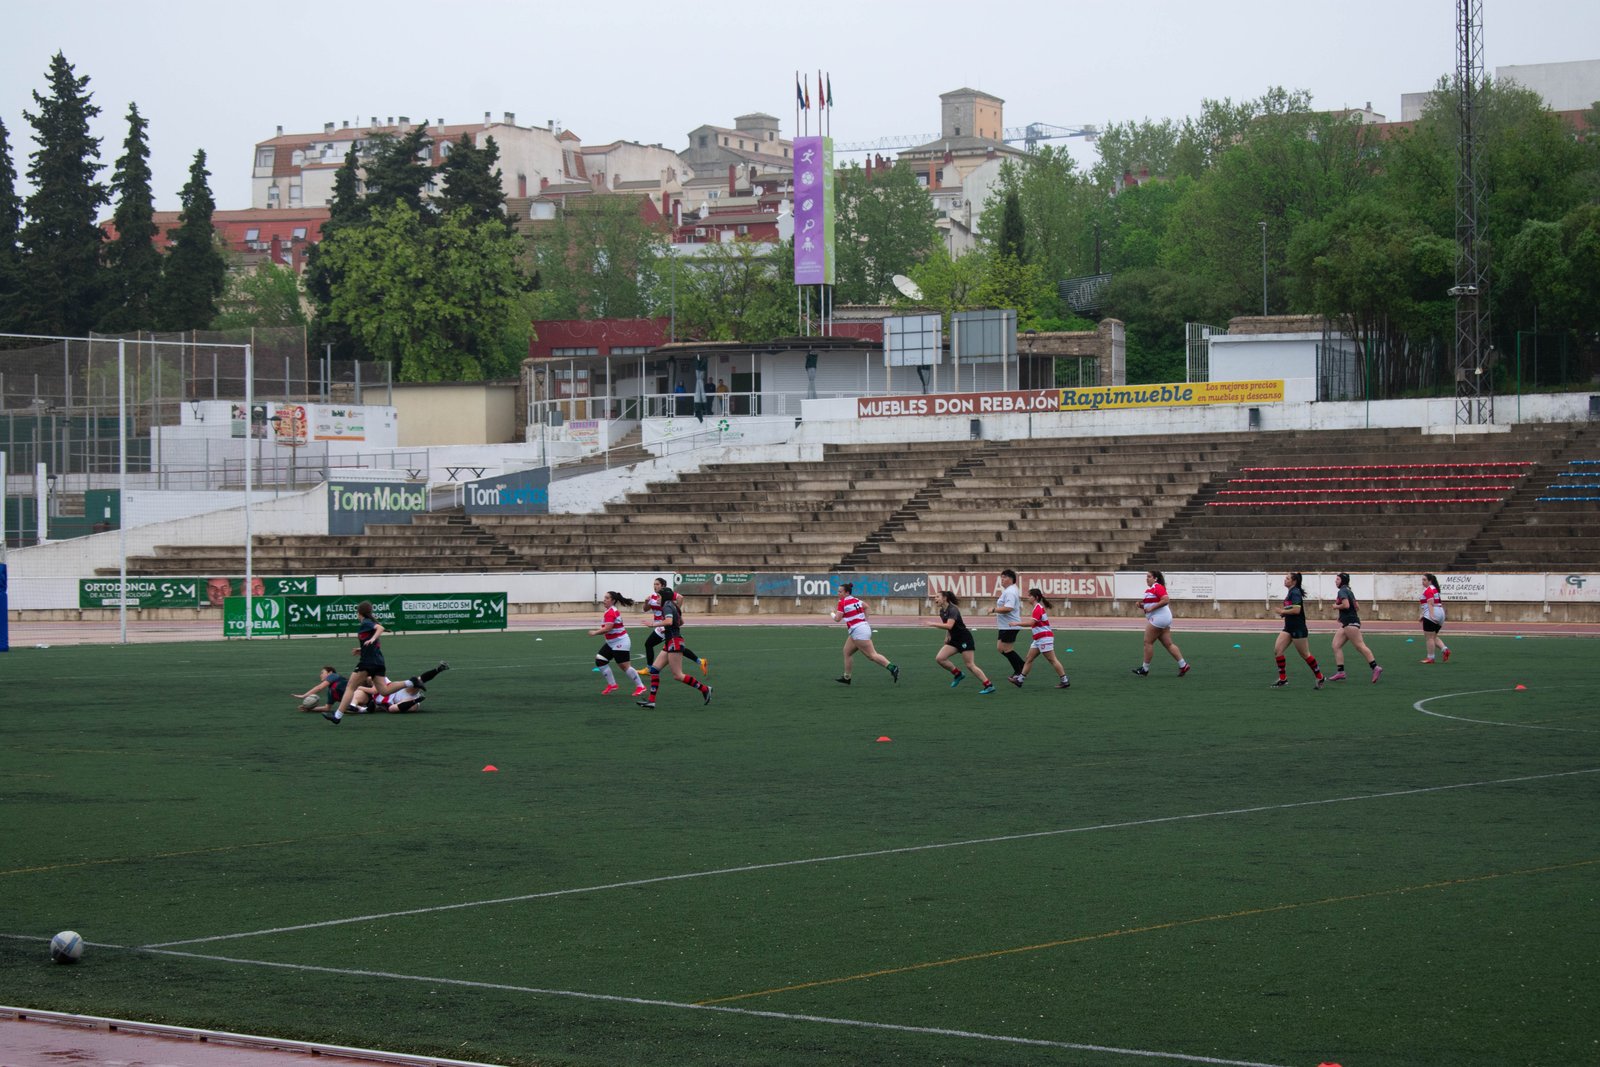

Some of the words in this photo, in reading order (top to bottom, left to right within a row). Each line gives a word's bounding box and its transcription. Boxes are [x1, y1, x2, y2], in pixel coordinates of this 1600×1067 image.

[1220, 383, 1249, 392] mejores
[1250, 382, 1277, 391] precios
[1061, 386, 1193, 408] Rapimueble
[1208, 393, 1239, 401] muebles
[1240, 394, 1245, 402] y
[1246, 392, 1282, 400] descanso
[859, 399, 928, 416] MUEBLES
[935, 398, 974, 413] DON
[980, 391, 1058, 412] REBAJÓN
[1445, 575, 1472, 583] MESÓN
[84, 582, 157, 592] ORTODONCIA
[947, 575, 1023, 597] MILLA
[1029, 578, 1096, 595] MUEBLES
[326, 604, 344, 612] ALTA
[345, 602, 390, 612] TECOGÍA
[403, 602, 432, 610] CENTRO
[460, 601, 470, 609] SM
[331, 612, 360, 620] ATENCIÓ
